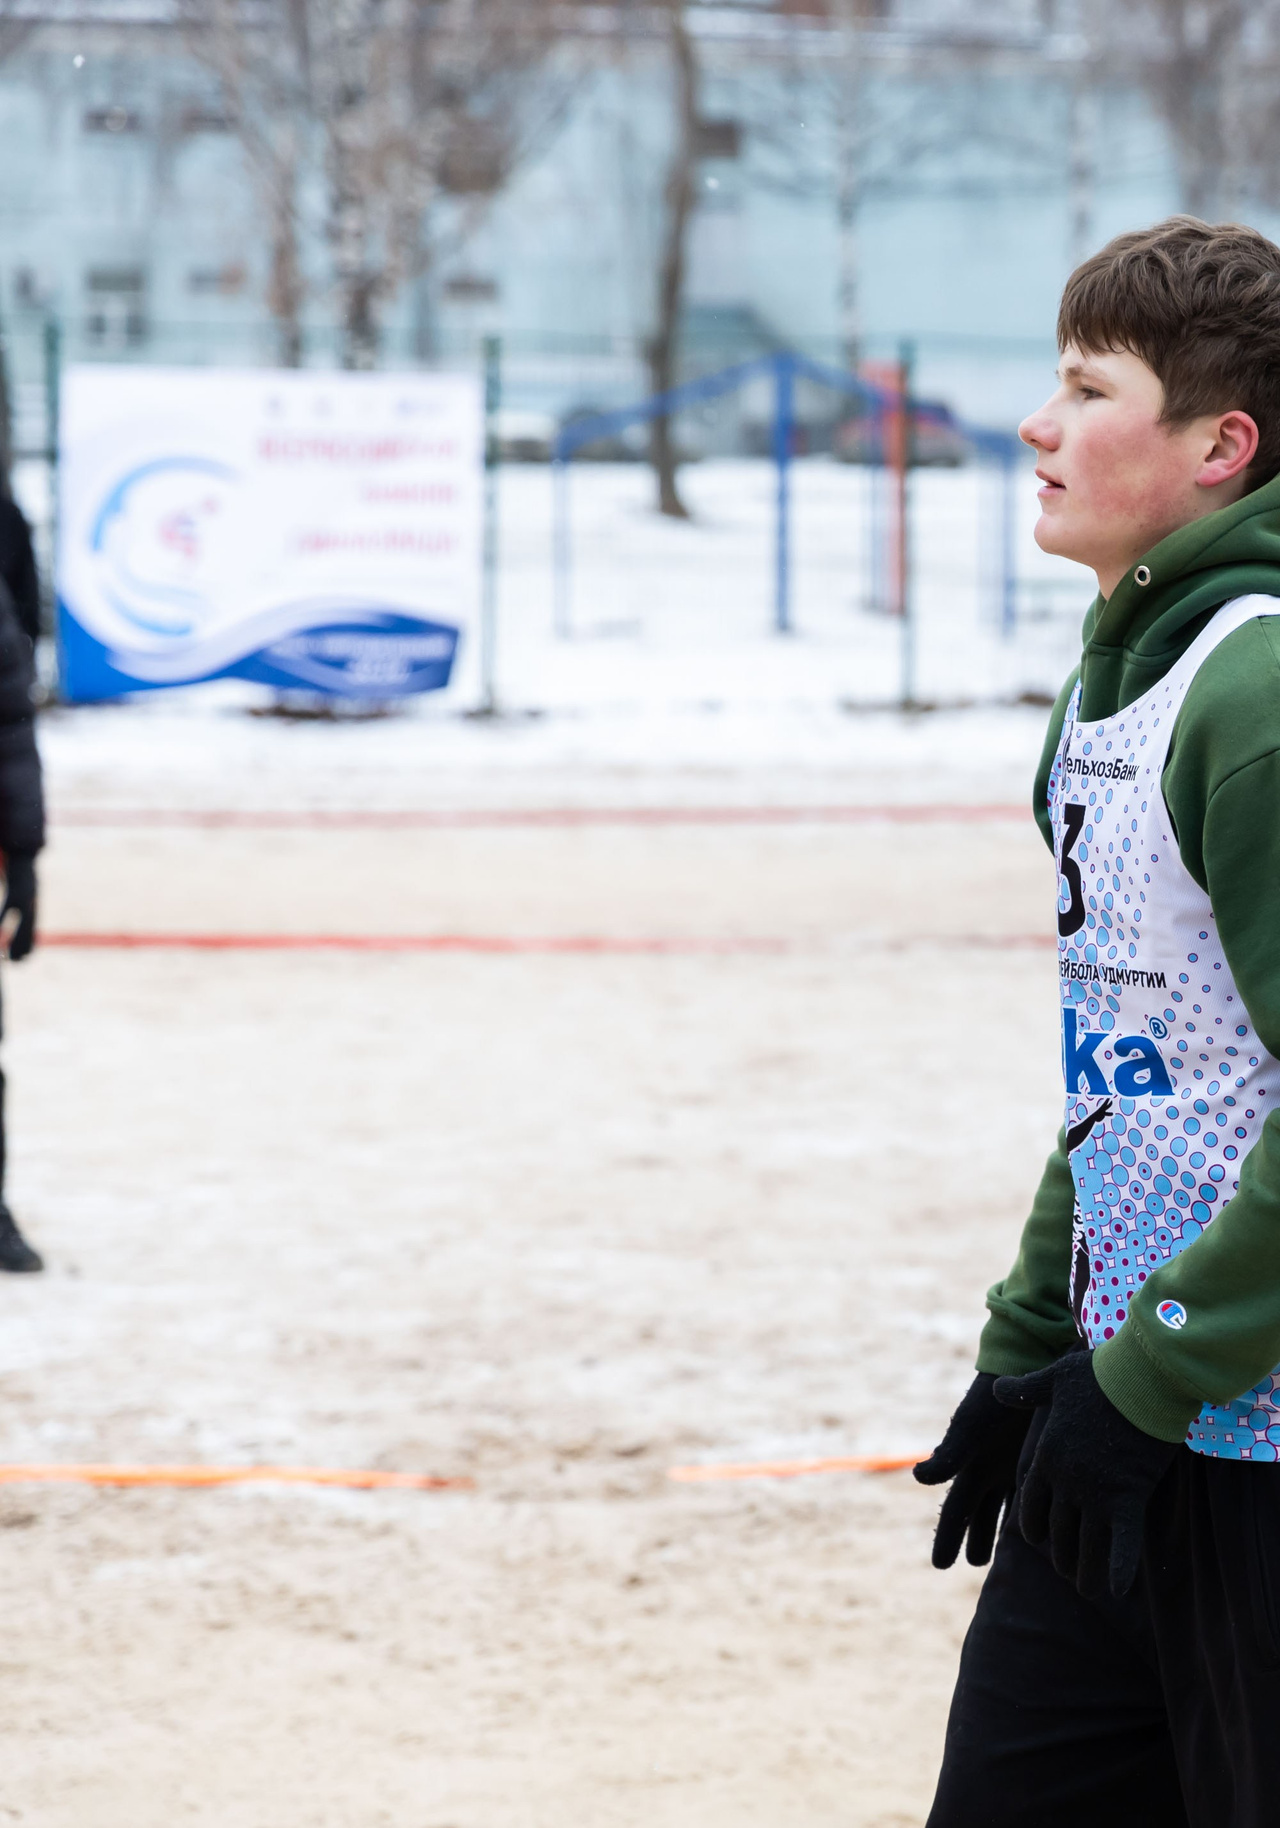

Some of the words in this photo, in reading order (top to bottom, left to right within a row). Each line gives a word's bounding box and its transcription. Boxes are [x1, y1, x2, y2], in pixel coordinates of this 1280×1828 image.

[1058, 803, 1086, 937] 3
[1059, 958, 1100, 982] ЕЙБОЛА
[1101, 966, 1167, 989] УДМУРТИИ
